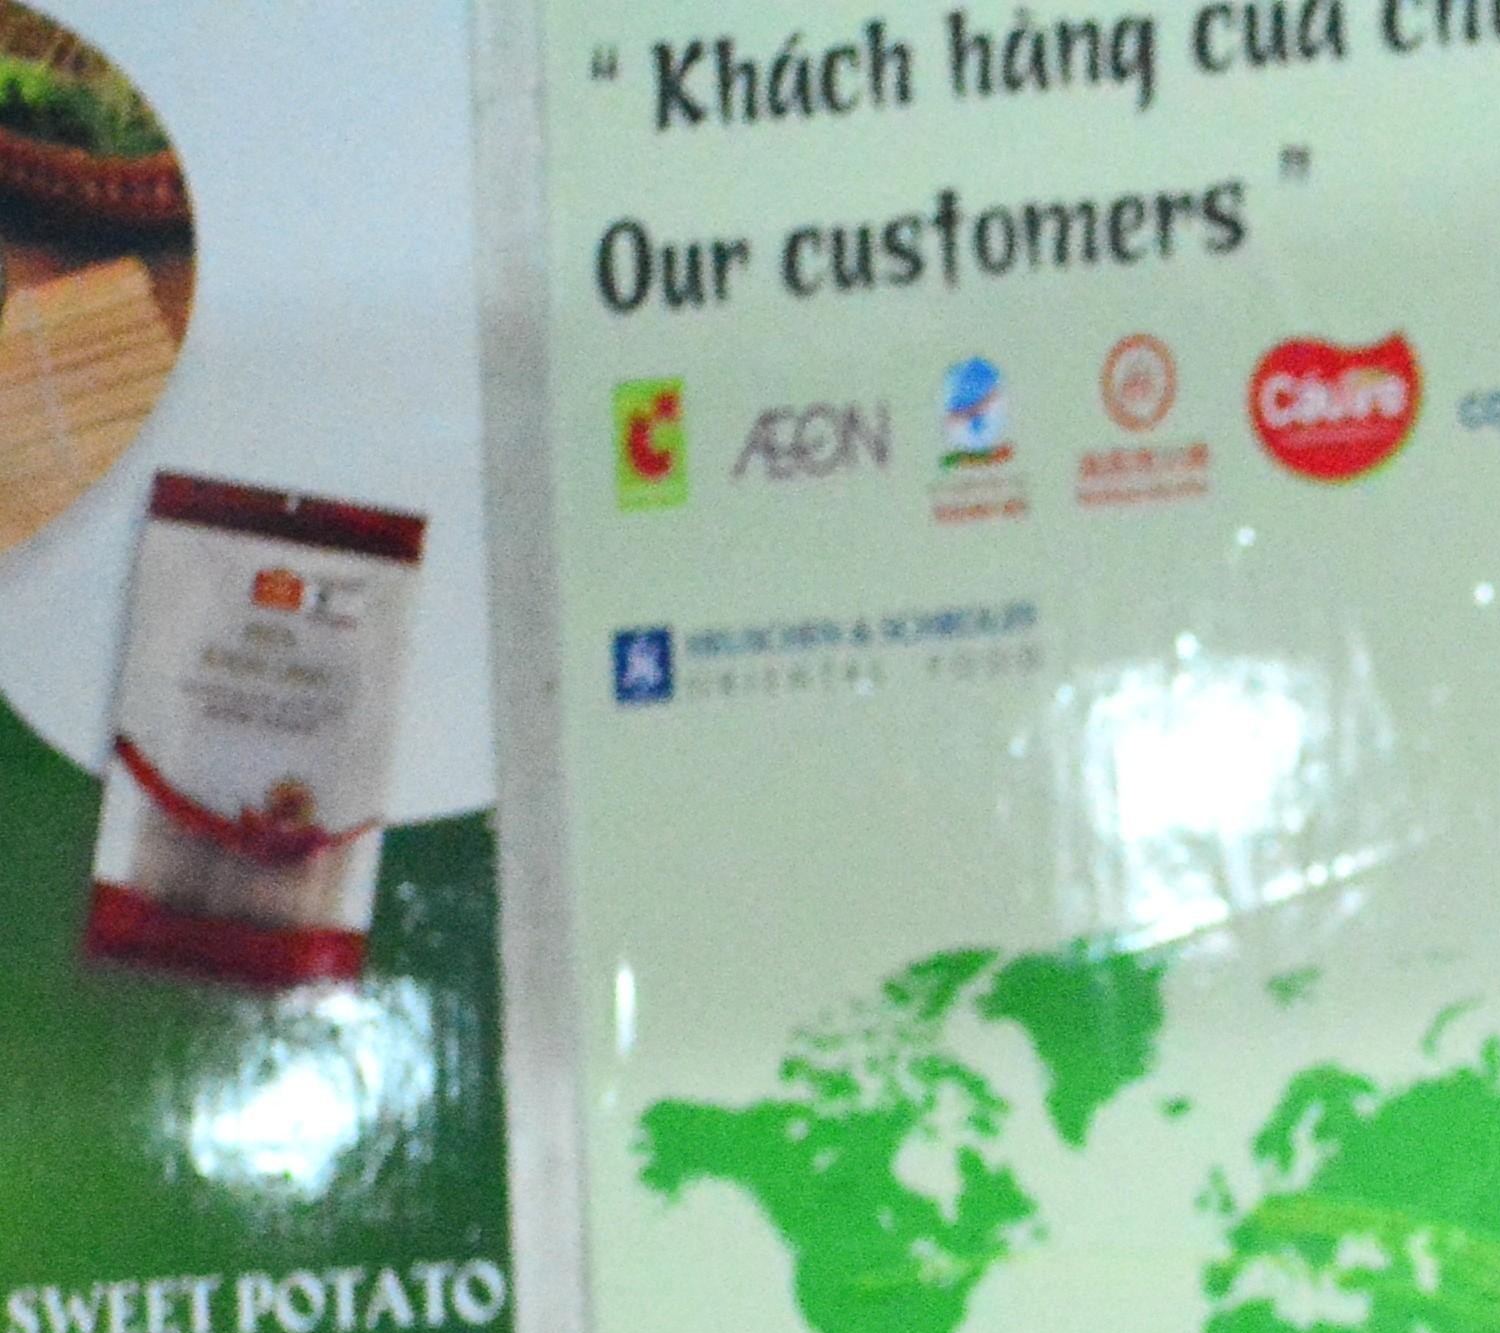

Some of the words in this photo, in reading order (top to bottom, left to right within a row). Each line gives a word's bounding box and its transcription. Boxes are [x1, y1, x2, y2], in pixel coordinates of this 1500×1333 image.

[651, 15, 912, 132] Khách
[596, 215, 750, 316] Our
[782, 177, 1248, 298] customers
